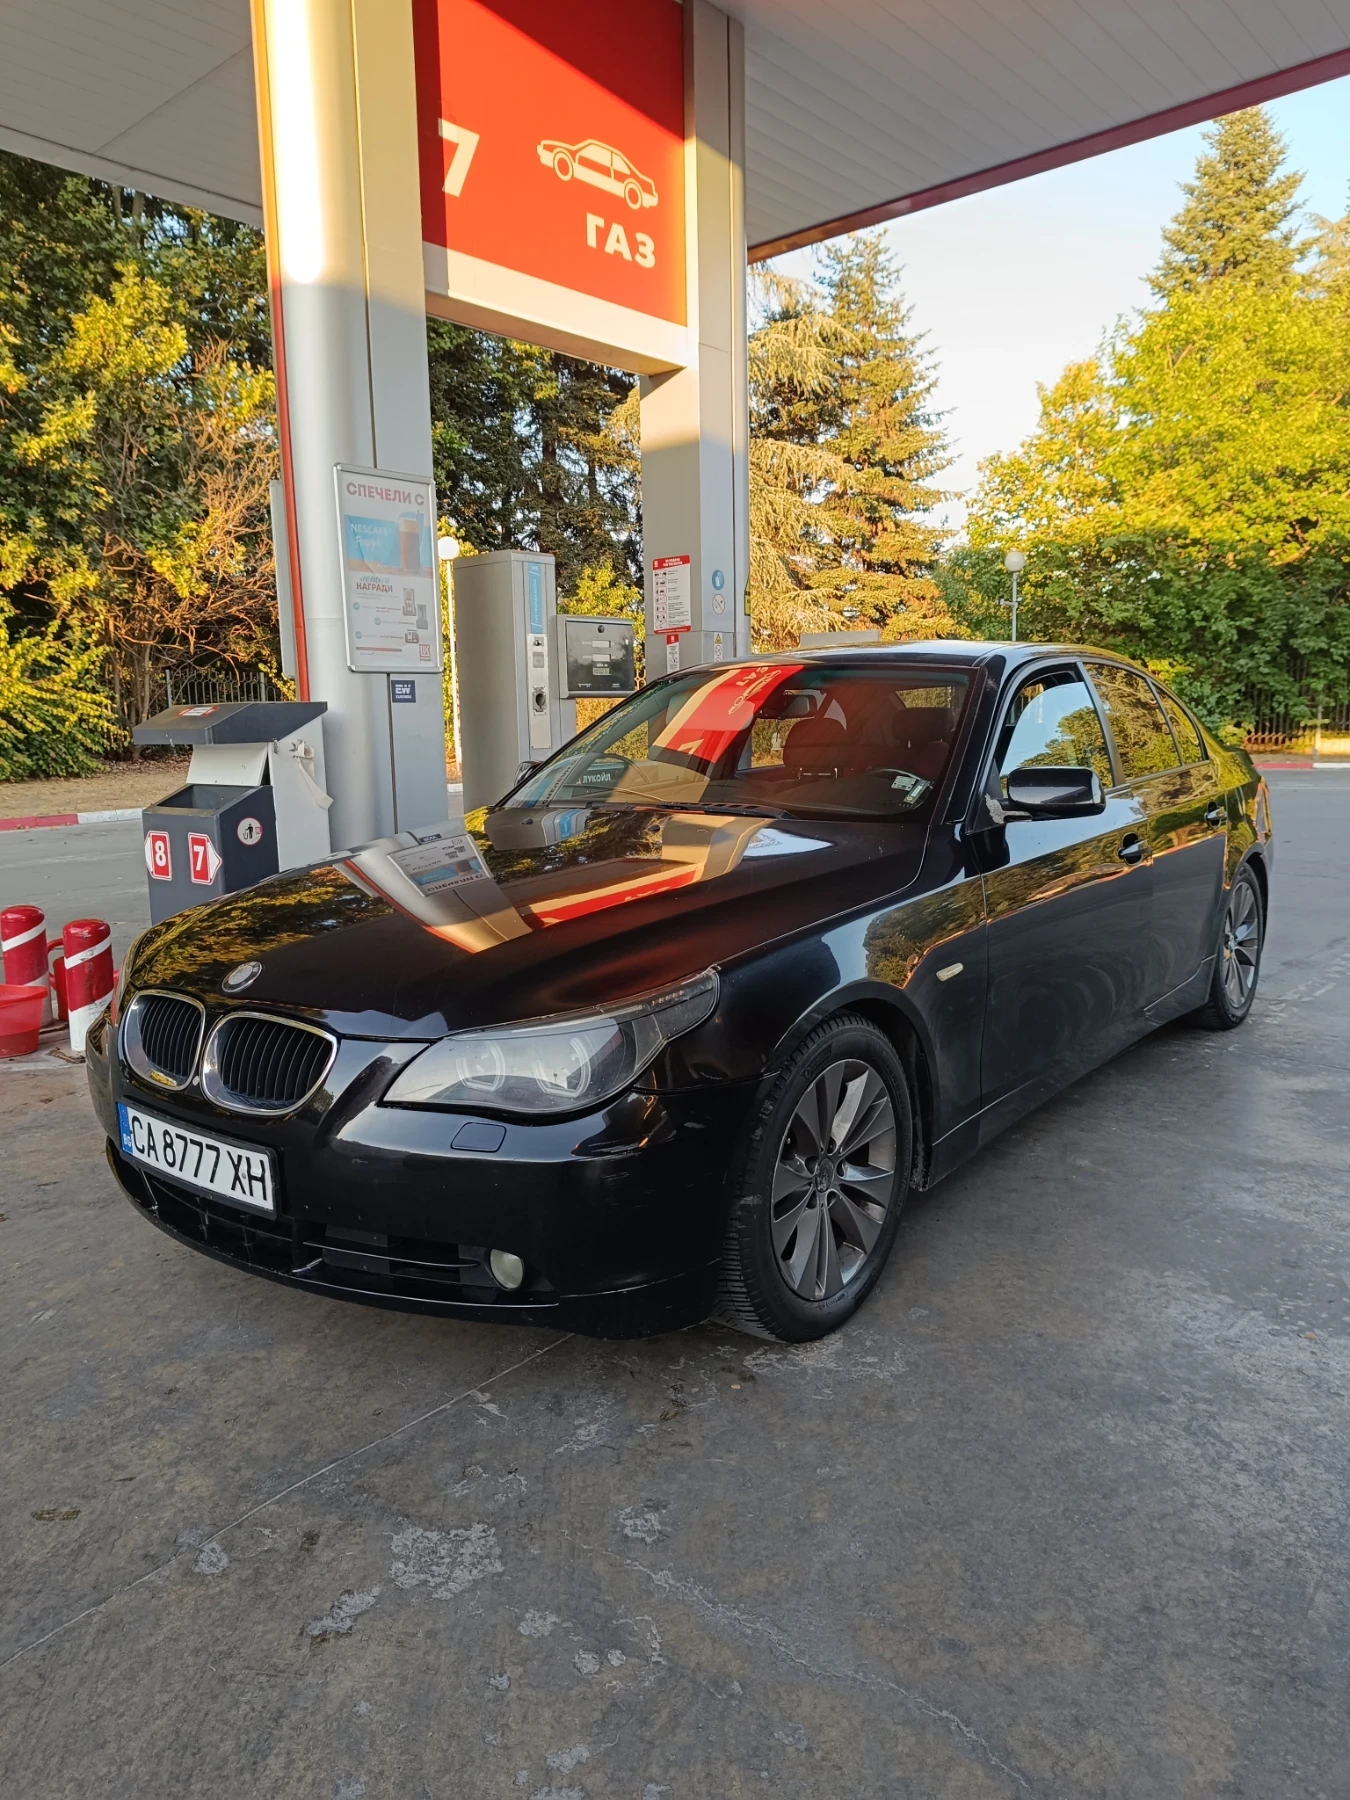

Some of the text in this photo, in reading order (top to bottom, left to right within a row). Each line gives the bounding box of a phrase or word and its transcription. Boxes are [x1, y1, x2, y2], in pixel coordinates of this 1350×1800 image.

[438, 118, 480, 197] 7
[585, 213, 656, 269] ГАЗ
[346, 482, 425, 506] СПЕЧЕЛИ С
[356, 582, 393, 593] НАГРАДИ
[582, 772, 611, 784] ЛУКОЙЛ
[154, 840, 167, 867] 8
[193, 845, 205, 871] 7
[163, 1129, 221, 1184] 8777
[226, 1151, 268, 1201] XH
